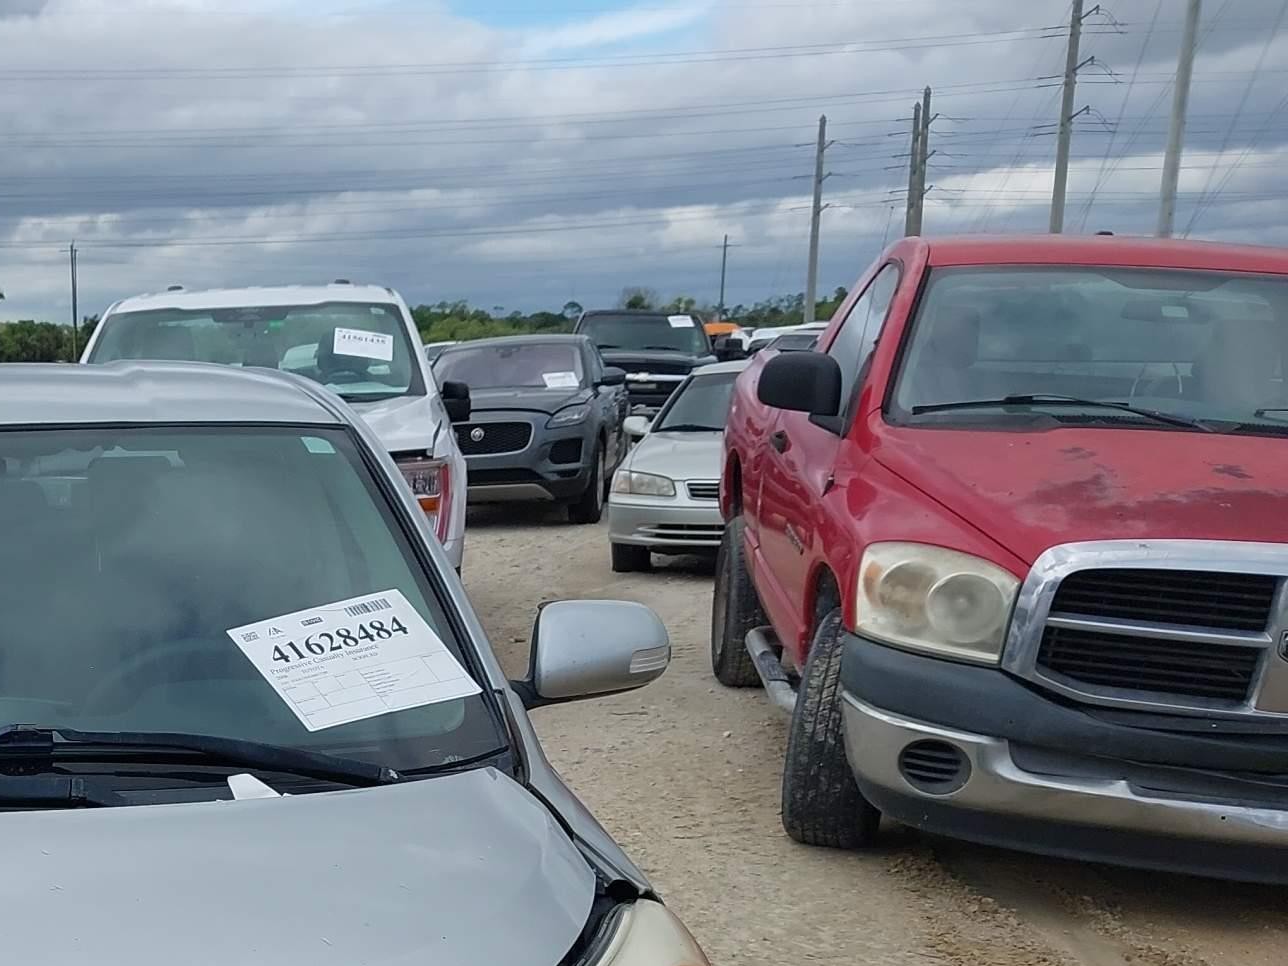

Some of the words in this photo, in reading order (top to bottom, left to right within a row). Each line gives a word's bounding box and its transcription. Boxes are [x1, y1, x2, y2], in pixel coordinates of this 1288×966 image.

[272, 617, 408, 662] 41628484
[270, 660, 313, 674] Progressive
[312, 652, 345, 664] Casualty
[344, 644, 379, 656] Insurance
